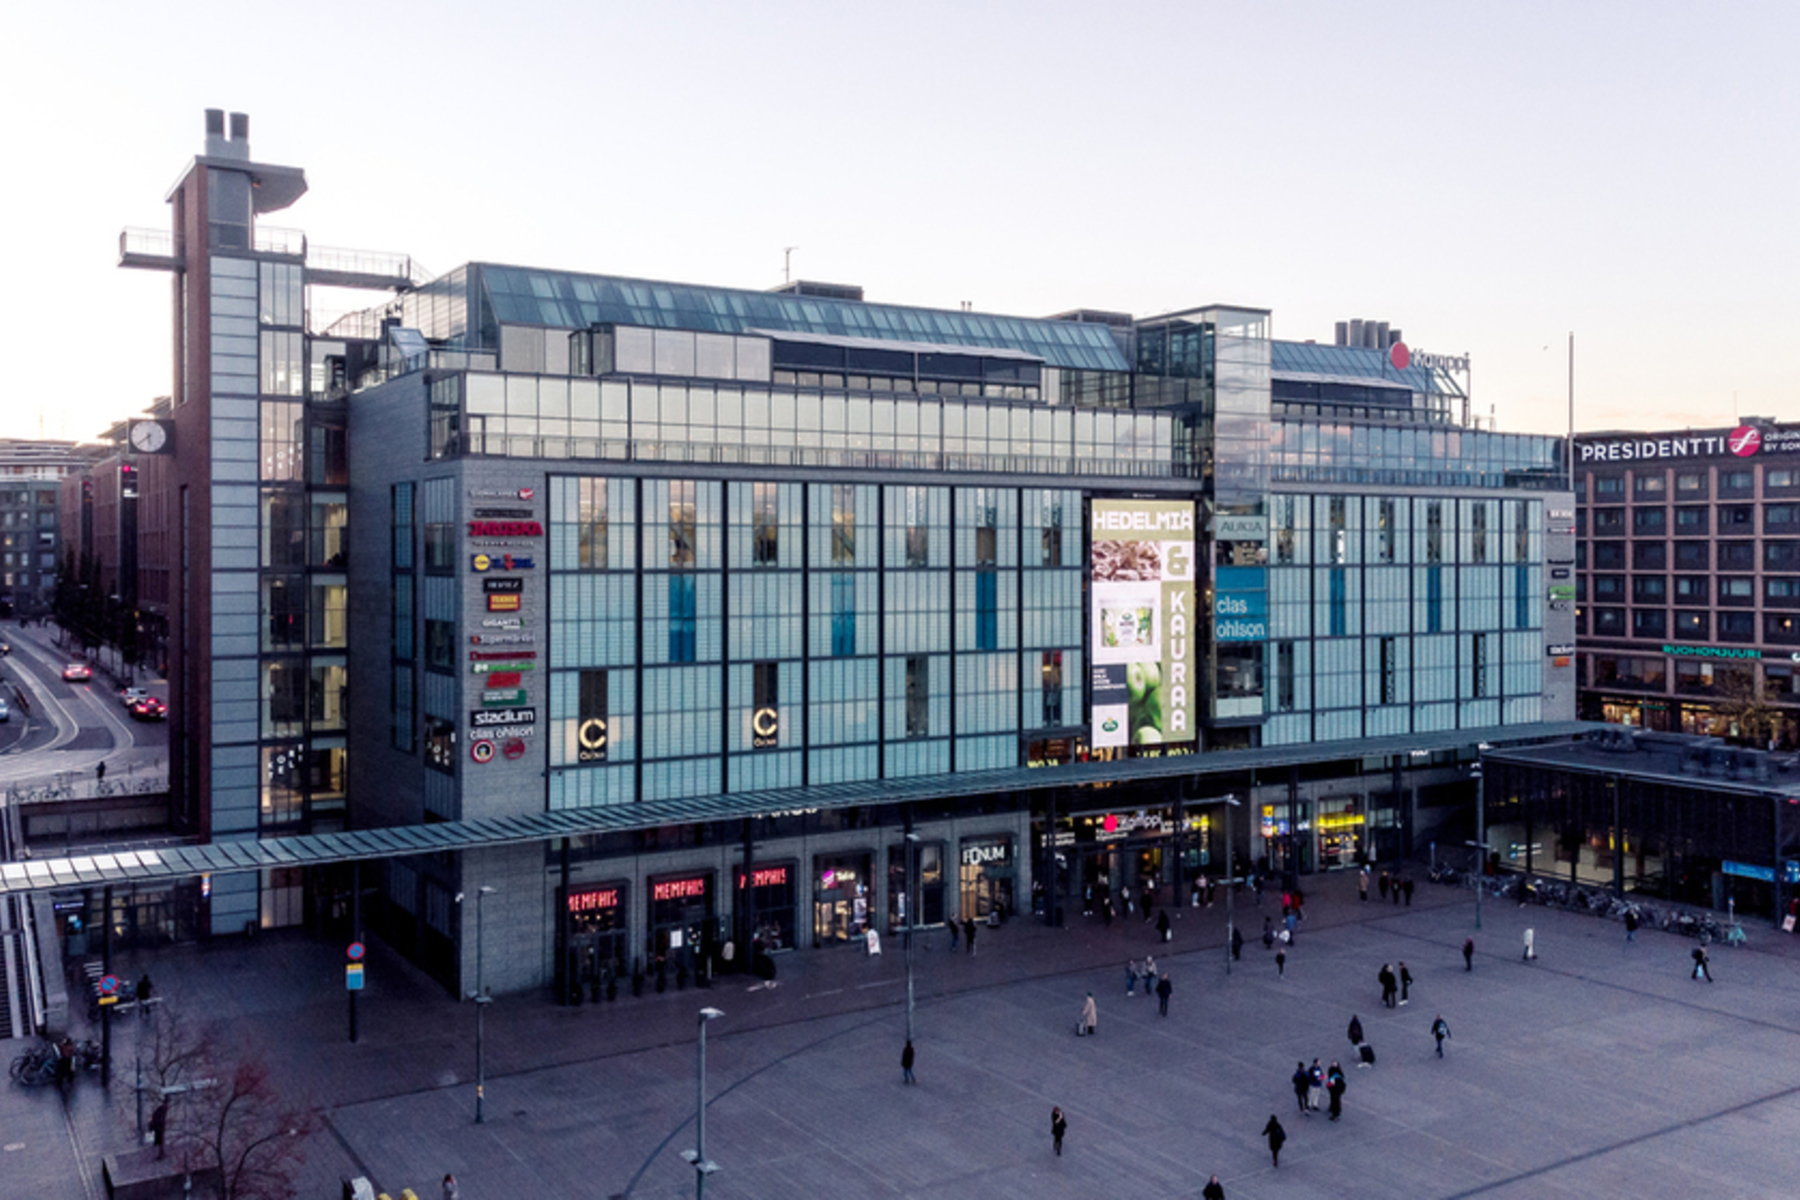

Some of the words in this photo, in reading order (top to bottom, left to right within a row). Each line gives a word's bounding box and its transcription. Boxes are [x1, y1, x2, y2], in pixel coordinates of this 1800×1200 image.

[1413, 348, 1471, 375] Kamppi
[1581, 436, 1725, 461] PRESIDENTTI
[1093, 509, 1193, 530] HEDELMIÄ
[1216, 595, 1248, 614] clas
[1216, 620, 1265, 638] ohlson
[474, 710, 534, 726] stadium
[496, 726, 534, 739] ohlson
[739, 868, 786, 889] EMPHIS
[654, 879, 705, 900] MEMPHIS
